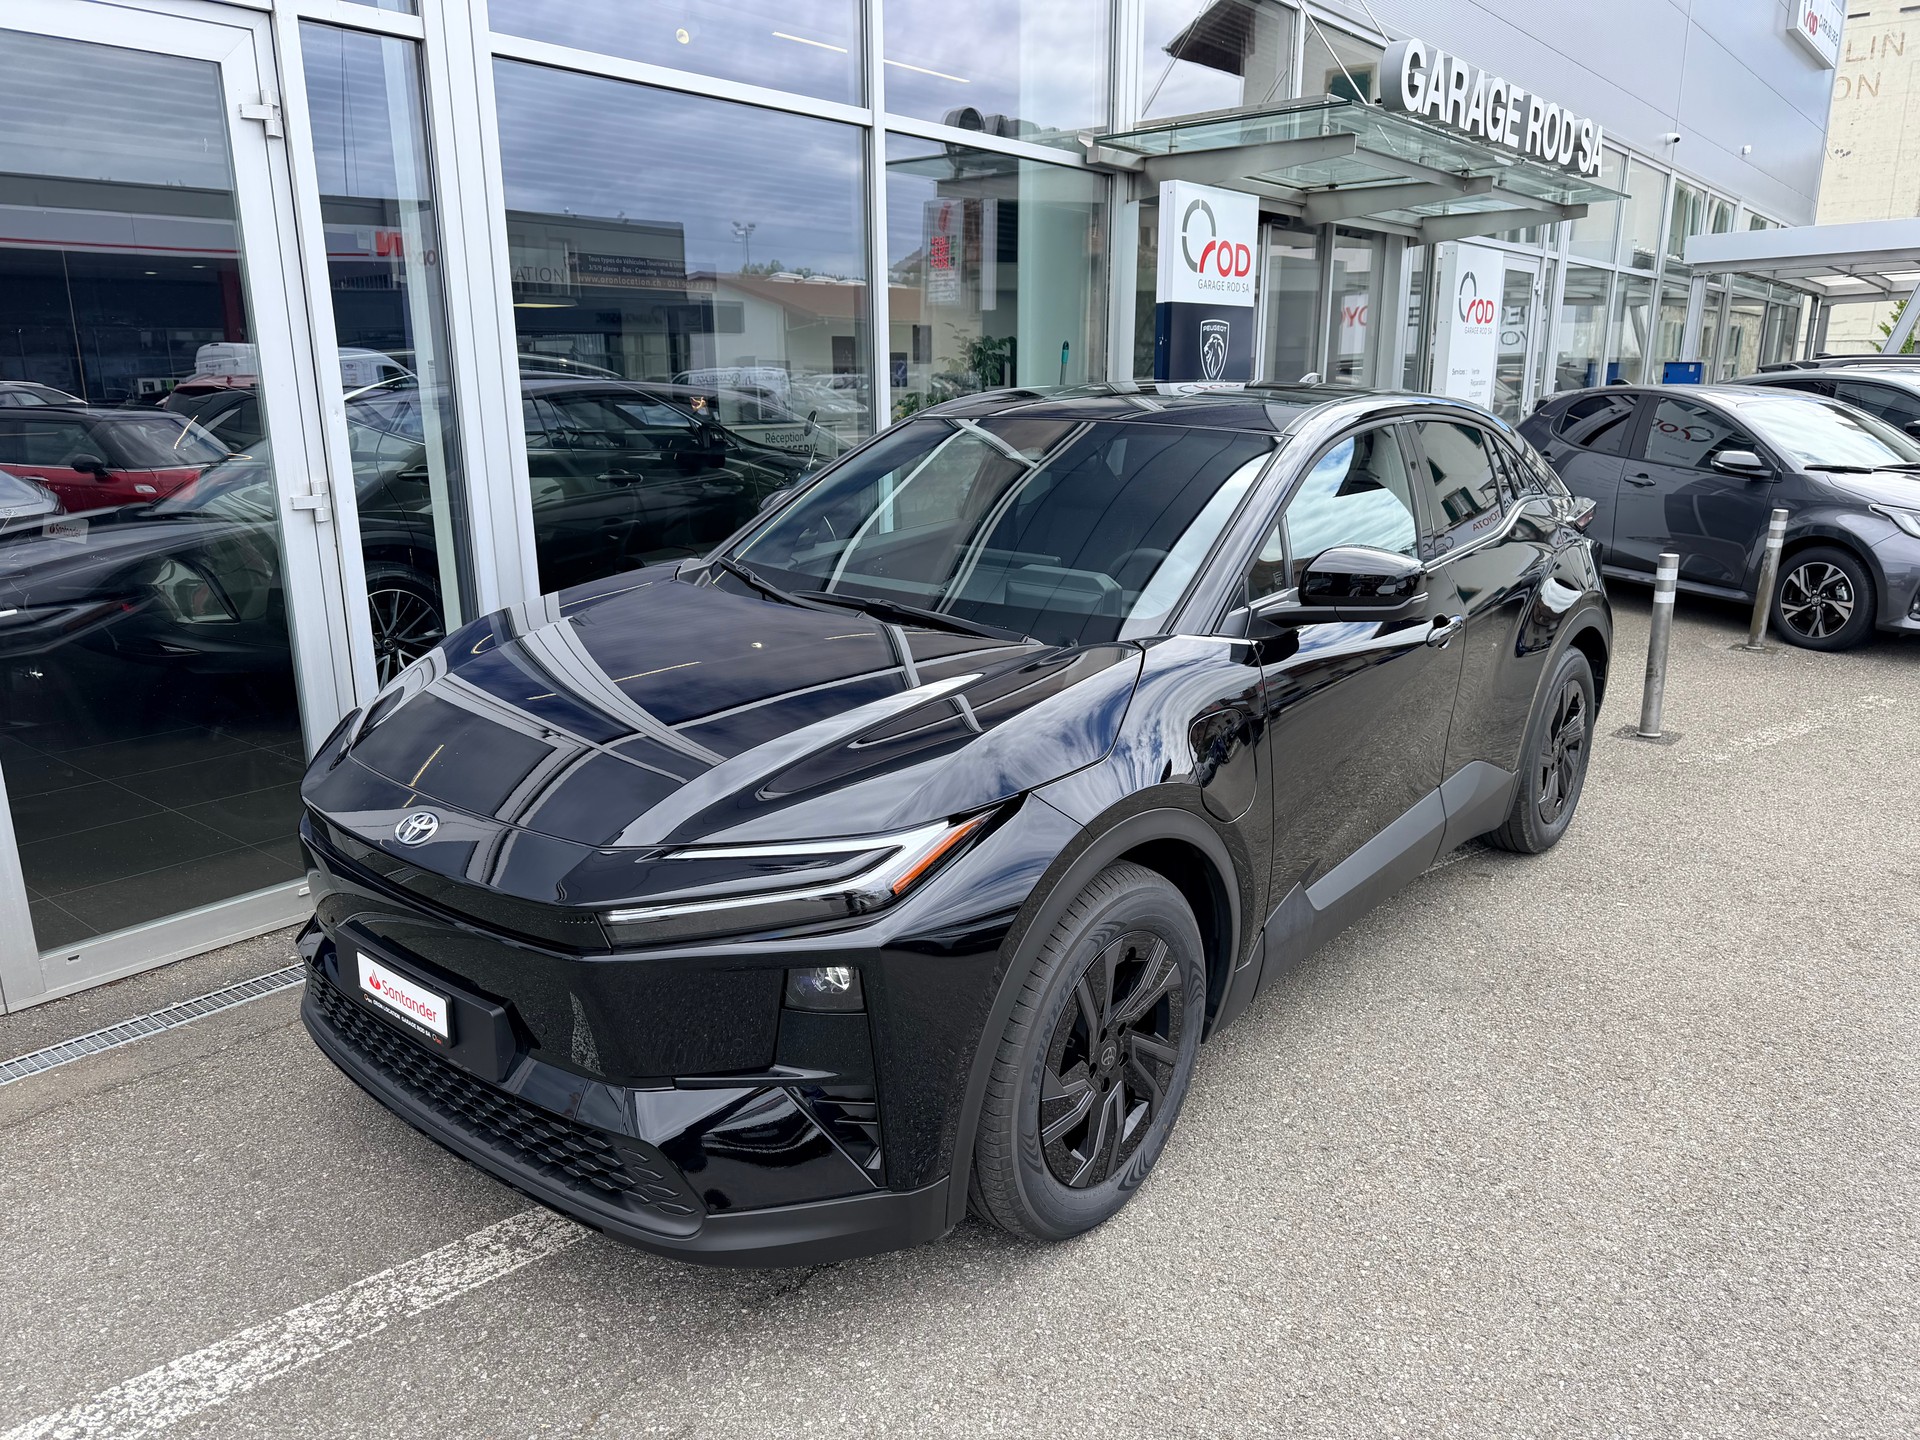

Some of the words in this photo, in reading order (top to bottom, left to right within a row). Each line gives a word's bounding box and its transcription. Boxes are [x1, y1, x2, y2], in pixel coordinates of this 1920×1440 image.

[1401, 38, 1525, 149] GARAGE
[1525, 94, 1575, 165] ROD
[1578, 117, 1603, 177] SA
[1197, 279, 1225, 291] GARAGE
[1226, 281, 1241, 293] ROD
[1242, 283, 1250, 293] SA
[1464, 326, 1479, 335] GARAGE
[765, 431, 805, 445] Réception
[381, 979, 437, 1023] Santander
[1030, 960, 1081, 1086] DUNLOP
